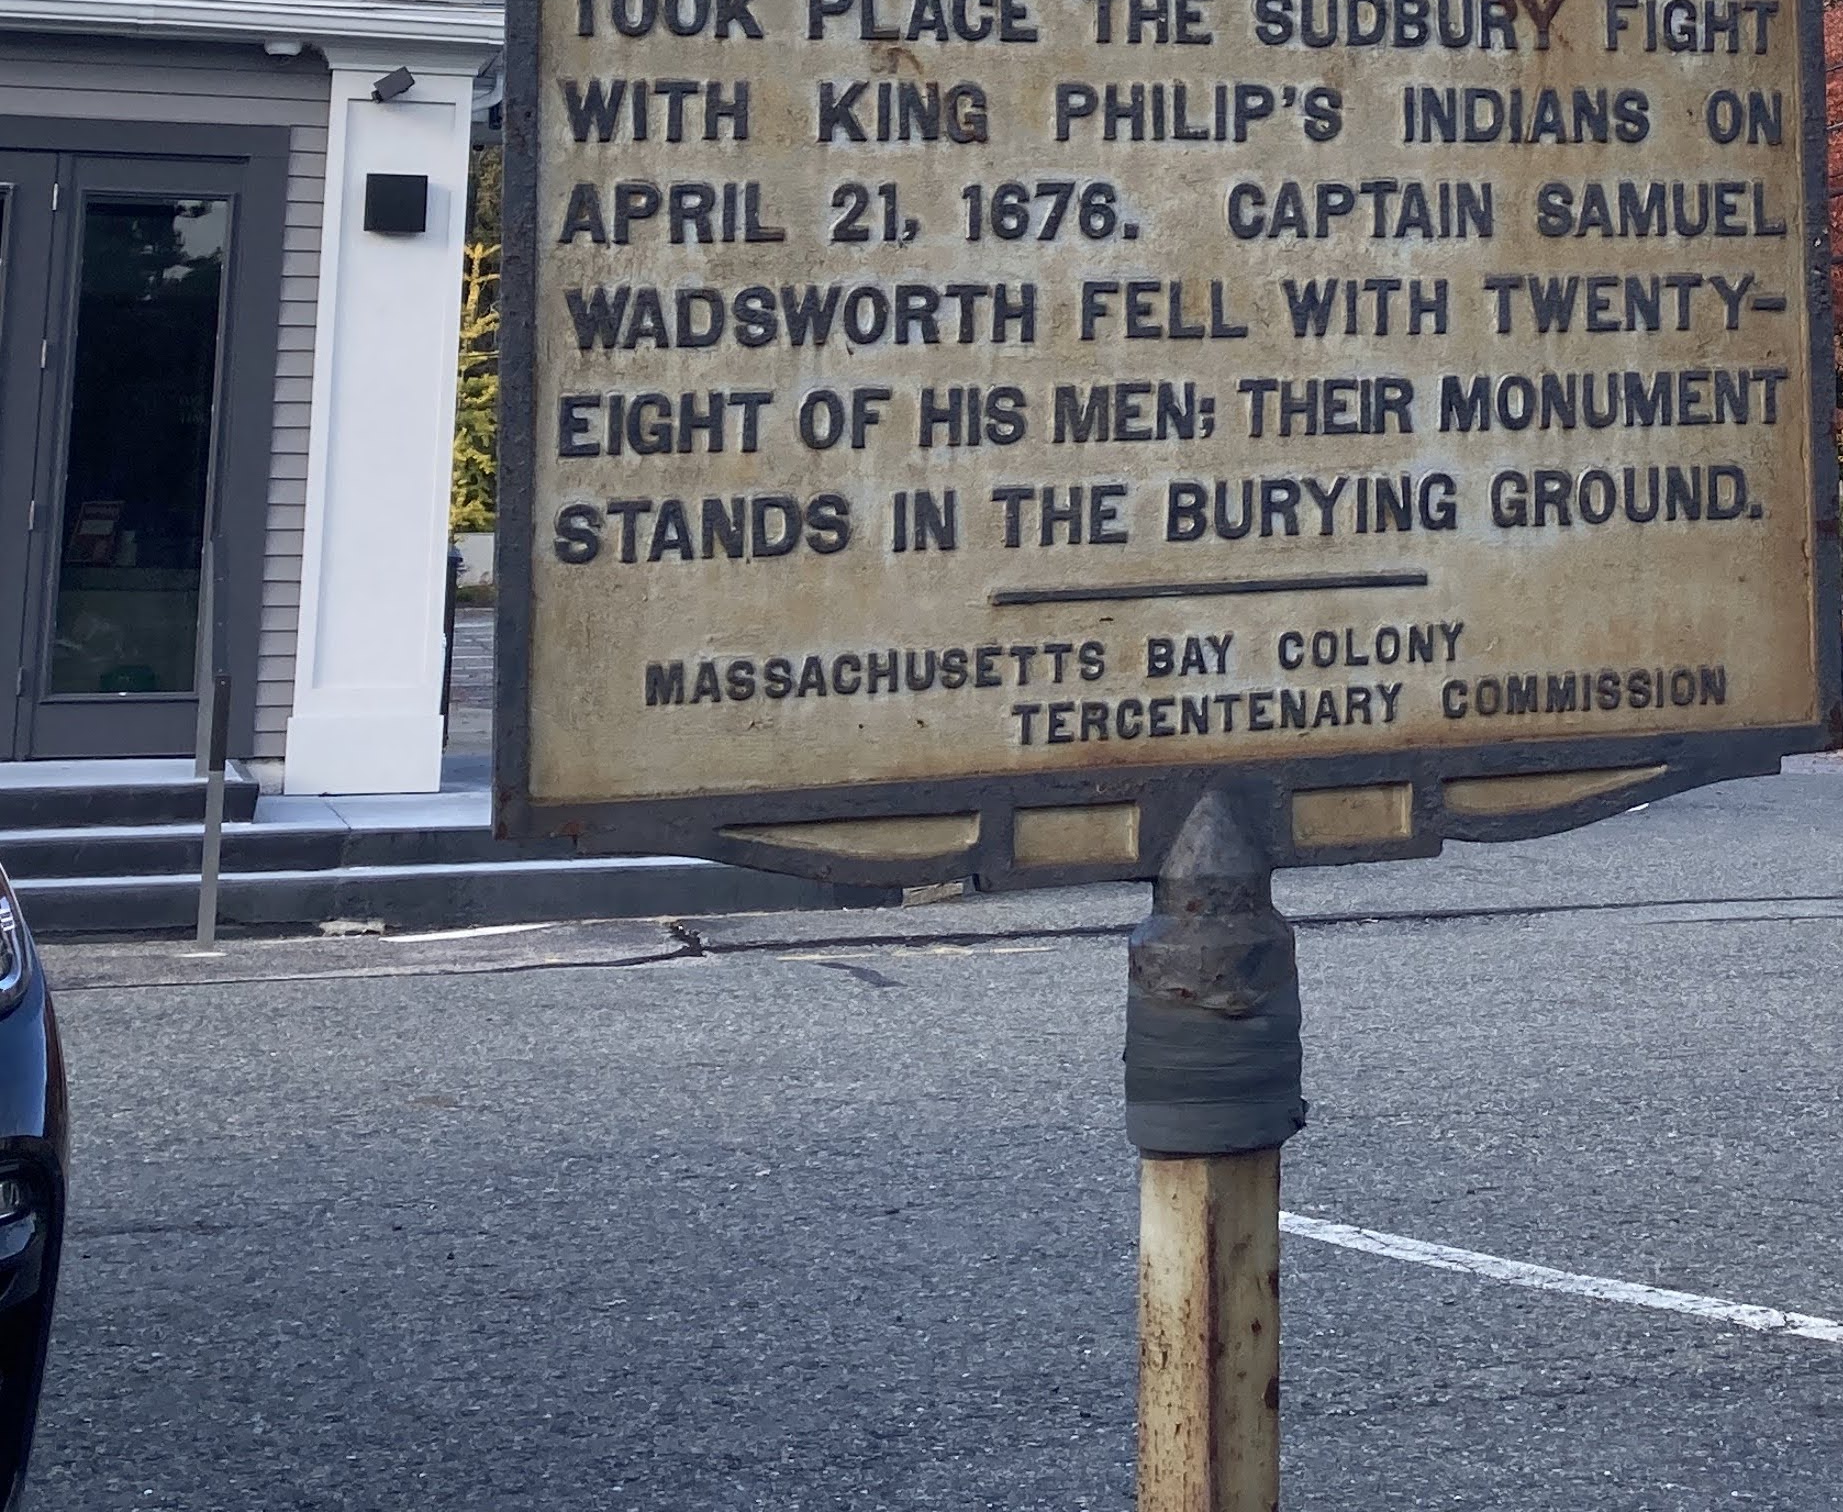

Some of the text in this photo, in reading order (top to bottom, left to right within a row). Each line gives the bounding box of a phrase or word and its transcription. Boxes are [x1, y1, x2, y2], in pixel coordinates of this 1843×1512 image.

[557, 78, 1783, 146] WITH KING PHILIP'S INDIANS ON
[557, 180, 1787, 245] APRIL 21, 1676. CAPTAIN SAMUEL
[564, 274, 1787, 350] WADSWORTH FELL WITH TWENTY-
[557, 367, 1789, 457] EIGHT OF HIS MEN; THEIR MONUMENT
[554, 464, 1763, 564] STANDS IN THE BURYING GROUND.
[644, 623, 1464, 706] MASSACHUSETTS BAY COLONY
[1012, 665, 1728, 744] TERCENTENARY COMMISSION
